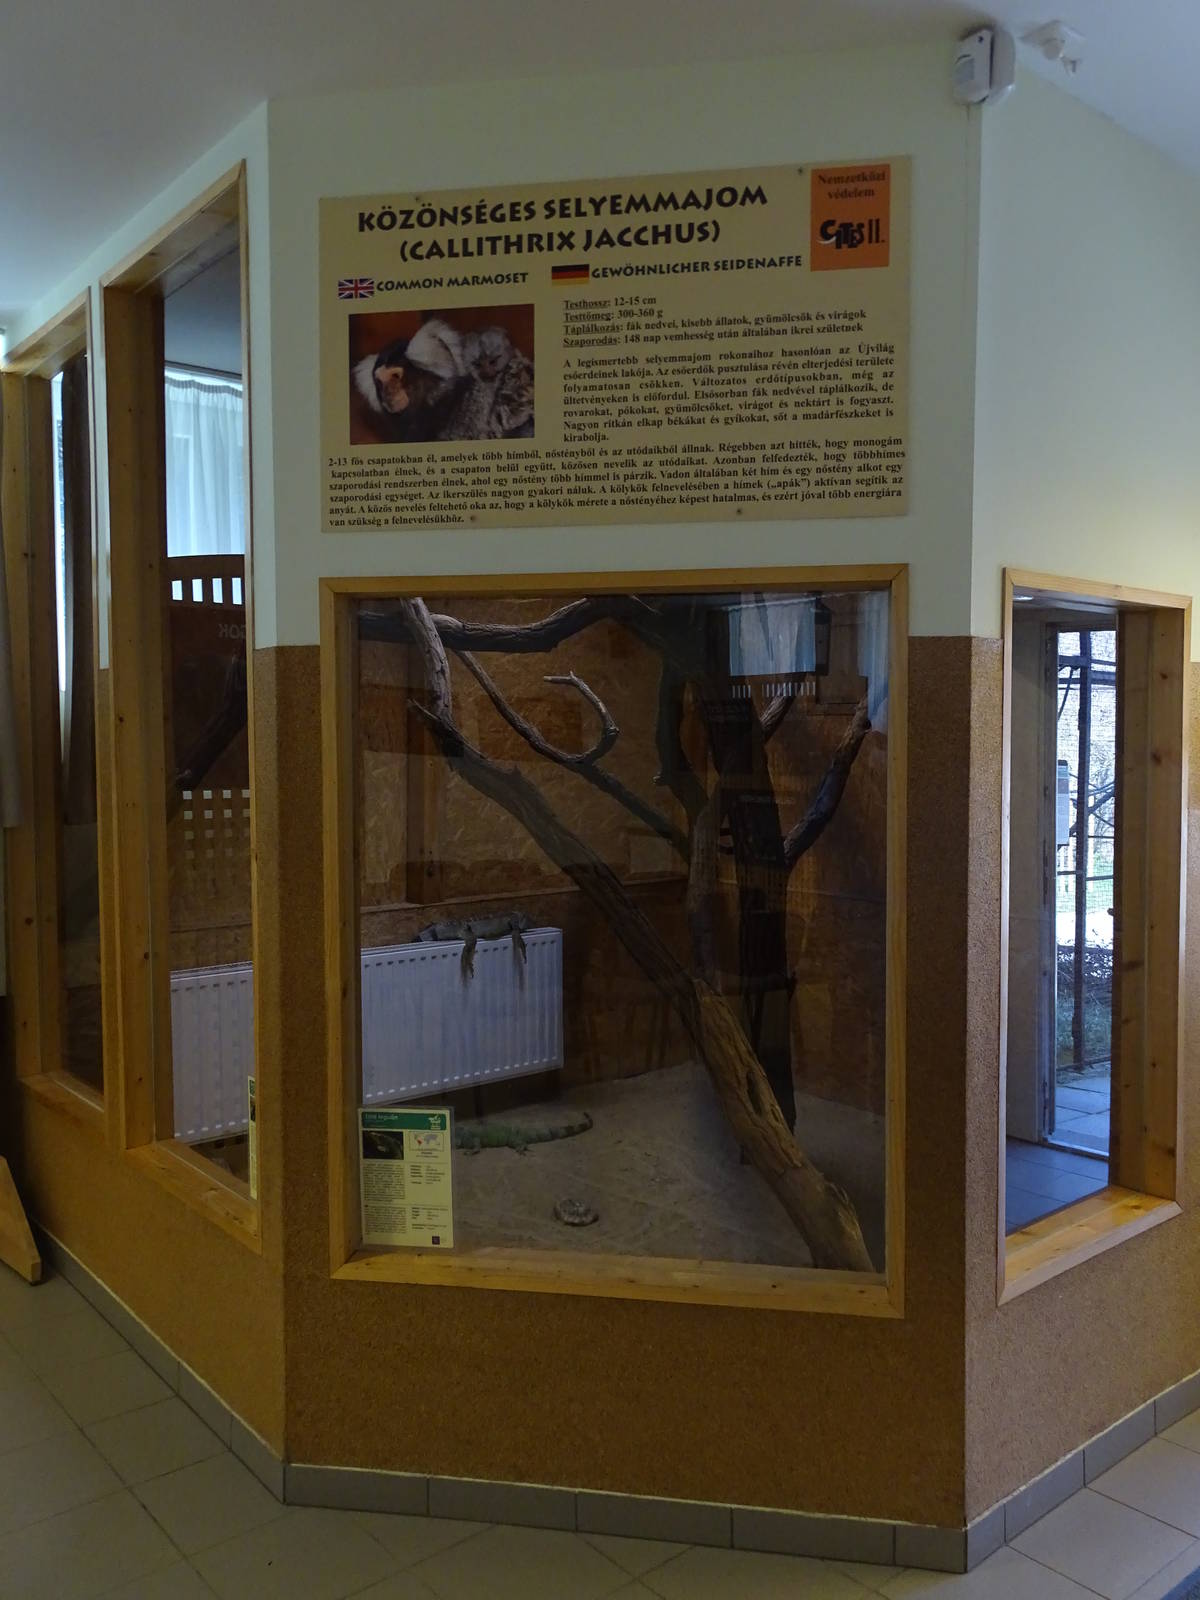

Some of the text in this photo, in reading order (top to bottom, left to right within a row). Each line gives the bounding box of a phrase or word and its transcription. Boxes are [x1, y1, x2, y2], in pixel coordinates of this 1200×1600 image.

[358, 185, 767, 232] KÖZÖNSÉGES SELYEMMAJOM
[400, 220, 720, 262] (CALLITHRIX JACCHUS)
[592, 256, 802, 278] GEWÖHNLICHER SEIDENAFFE
[376, 272, 528, 291] COMMON MARMOSET
[564, 298, 610, 309] Testhossz:
[614, 296, 640, 306] 12-15
[617, 308, 655, 319] 300-360
[656, 310, 663, 319] g
[626, 321, 642, 331] fák
[681, 317, 713, 328] kisebb
[753, 312, 813, 326] gyümölcsök
[815, 311, 826, 320] és
[827, 309, 867, 322] virágok
[624, 334, 641, 343] 148
[643, 335, 661, 345] nap
[664, 330, 714, 343] vemhesség
[717, 329, 739, 338] után
[742, 326, 788, 337] általában
[791, 325, 814, 335] ikrei
[816, 322, 863, 333] születnek
[562, 359, 571, 368] A
[577, 356, 639, 369] legismertebb
[645, 352, 712, 366] selyemmajom
[718, 349, 774, 360] rokonaihoz
[781, 346, 832, 357] hasonlóan
[857, 341, 895, 355] Újvilág
[655, 367, 669, 376] Az
[717, 362, 769, 375] pusztulása
[771, 360, 799, 370] révén
[801, 357, 853, 371] elterjedési
[855, 355, 895, 366] területe
[563, 381, 631, 395] folyamatosan
[692, 375, 747, 387] Változatos
[851, 369, 874, 381] még
[882, 370, 895, 378] az
[632, 393, 640, 402] is
[751, 387, 769, 397] fák
[772, 385, 815, 396] nedvével
[881, 381, 895, 391] de
[738, 394, 894, 412] virágot és nektárt is fogyaszt.
[563, 420, 599, 432] Nagyon
[603, 419, 633, 428] ritkán
[636, 417, 663, 429] elkap
[667, 415, 706, 426] békákat
[709, 415, 720, 424] és
[802, 408, 881, 420] madárfészkeket
[885, 407, 894, 416] is
[563, 432, 609, 445] kirabolja.
[328, 458, 348, 467] 2-13
[367, 455, 423, 468] csapatokban
[440, 453, 479, 465] amelyek
[481, 452, 503, 461] több
[598, 447, 609, 456] és
[626, 445, 678, 455] utódaikból
[681, 443, 715, 453] állnak.
[718, 441, 766, 454] Régebben
[769, 440, 785, 449] azt
[824, 438, 849, 449] hogy
[853, 435, 903, 448] monogám
[331, 468, 390, 481] kapcsolatban
[426, 467, 436, 475] és
[450, 464, 491, 476] csapaton
[496, 463, 519, 473] belül
[561, 460, 598, 470] közösen
[603, 459, 638, 468] nevelik
[712, 454, 756, 464] Azonban
[823, 451, 847, 462] hogy
[853, 448, 906, 459] többhímes
[329, 481, 381, 493] szaporodási
[384, 479, 439, 489] rendszerben
[471, 477, 491, 486] ahol
[493, 478, 508, 487] egy
[550, 474, 572, 483] több
[574, 472, 610, 482] hímmel
[612, 472, 620, 481] is
[623, 470, 657, 482] párzik.
[659, 469, 690, 479] Vadon
[693, 467, 739, 478] általában
[742, 467, 757, 476] két
[760, 466, 779, 475] hím
[782, 465, 793, 474] és
[795, 467, 811, 476] egy
[856, 462, 882, 472] alkot
[885, 463, 901, 473] egy
[329, 493, 382, 505] szaporodási
[384, 491, 425, 503] egységet.
[427, 491, 441, 499] Az
[442, 489, 488, 499] ikerszülés
[491, 490, 524, 499] nagyon
[527, 486, 563, 498] gyakori
[566, 485, 596, 495] náluk.
[599, 485, 607, 493] A
[610, 483, 648, 495] kölykök
[651, 481, 720, 492] felnevelésében
[733, 479, 763, 489] hímek
[814, 476, 852, 486] aktívan
[855, 475, 888, 487] segítik
[329, 506, 357, 517] anyát.
[357, 506, 366, 514] A
[367, 505, 392, 514] közös
[394, 503, 427, 513] nevelés
[469, 501, 487, 510] oka
[504, 500, 525, 511] hogy
[537, 498, 574, 510] kölykök
[576, 497, 609, 507] mérete
[679, 494, 710, 505] képest
[761, 491, 772, 500] és
[773, 491, 798, 500] ezért
[801, 490, 826, 501] jóval
[828, 489, 851, 498] több
[853, 487, 902, 499] energiára
[347, 517, 382, 528] szükség
